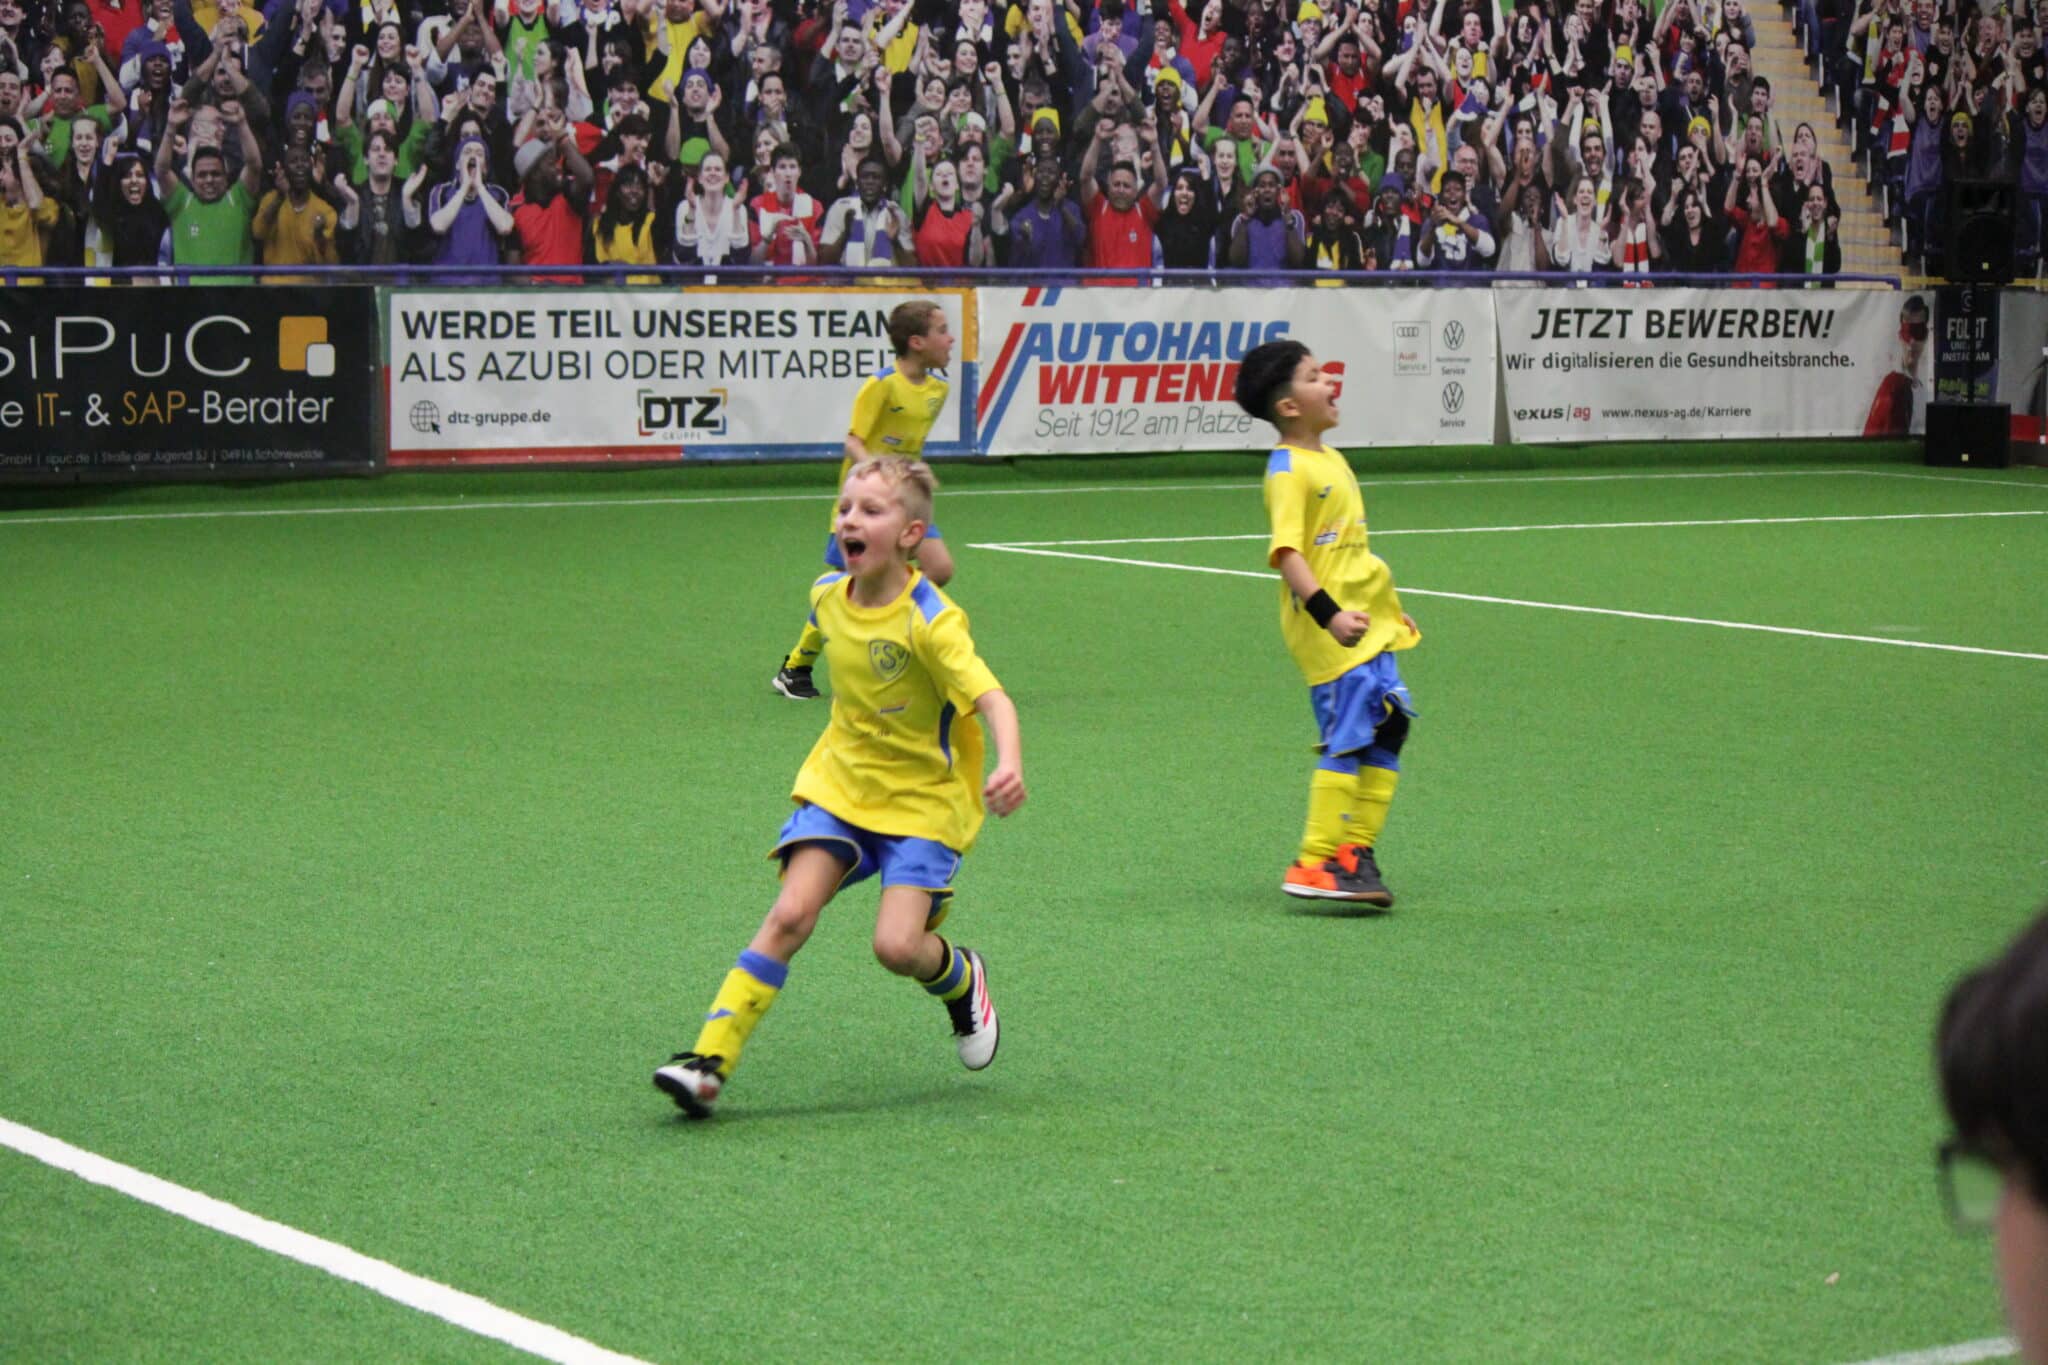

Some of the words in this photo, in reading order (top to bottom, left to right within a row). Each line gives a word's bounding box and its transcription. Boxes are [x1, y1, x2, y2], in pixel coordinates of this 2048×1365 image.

[401, 310, 536, 340] WERDE
[547, 310, 621, 339] TEIL
[633, 309, 797, 339] UNSERES
[1531, 308, 1633, 339] JETZT
[1645, 308, 1835, 339] BEWERBEN!
[1947, 318, 1988, 340] FOLT
[1023, 320, 1290, 362] AUTOHAUS
[400, 351, 466, 382] ALS
[477, 350, 592, 381] AZUBI
[605, 350, 705, 379] ODER
[1506, 353, 1536, 370] Wir
[1542, 352, 1654, 372] digitalisieren
[1658, 352, 1682, 368] die
[1687, 351, 1855, 369] Gesundheitsbranche.
[85, 393, 111, 427] &
[122, 389, 334, 426] SAP-Berater
[447, 410, 551, 427] dtz-gruppe.de
[644, 396, 721, 428] DTZ
[1036, 409, 1082, 438] Seit
[1089, 410, 1139, 436] 1912
[1143, 416, 1179, 435] am
[1184, 406, 1252, 434] Platze
[1440, 418, 1465, 428] Service
[1601, 405, 1752, 420] www.nexus-ag.de/Karriere
